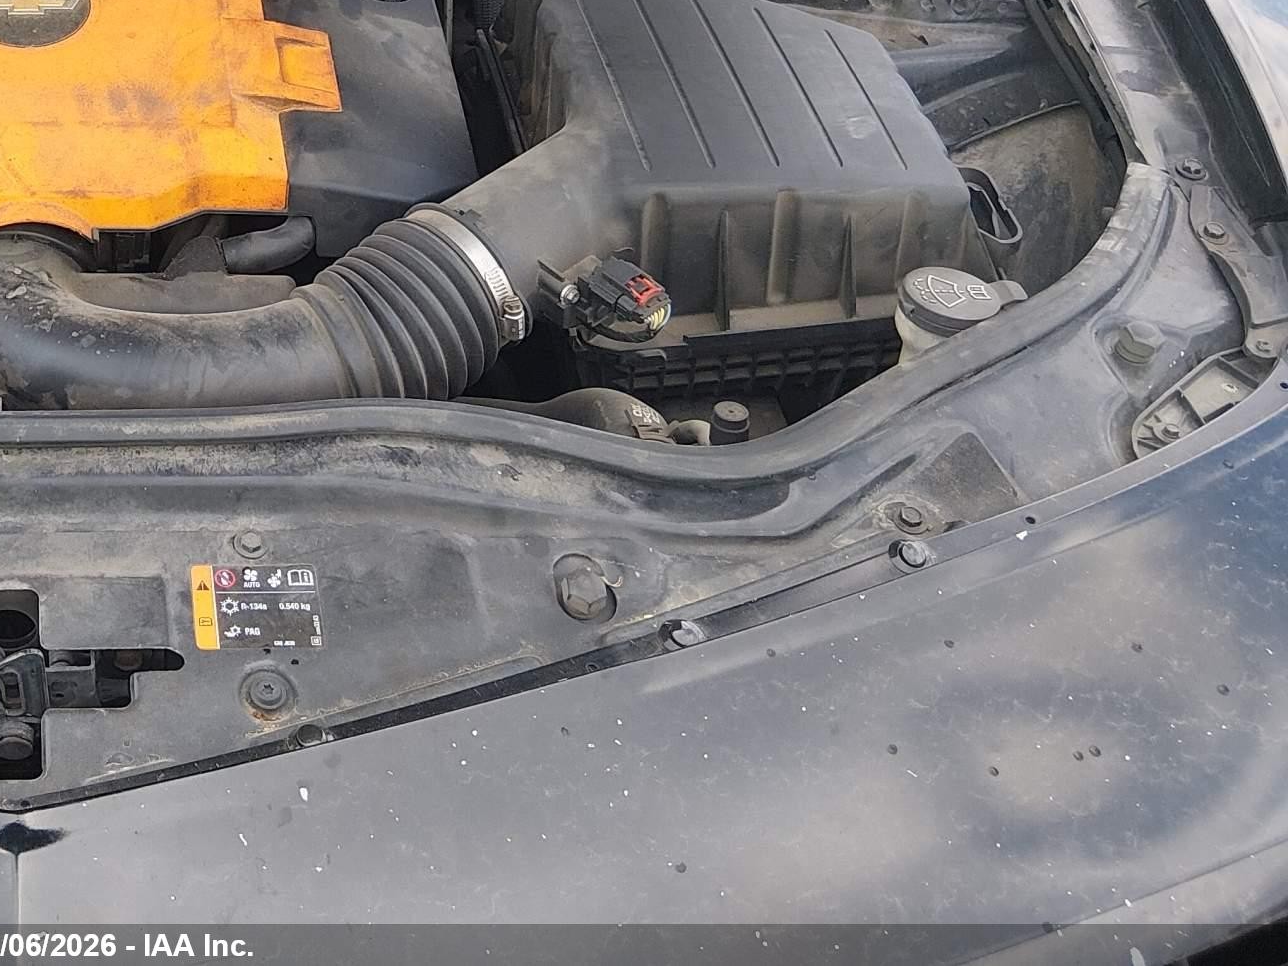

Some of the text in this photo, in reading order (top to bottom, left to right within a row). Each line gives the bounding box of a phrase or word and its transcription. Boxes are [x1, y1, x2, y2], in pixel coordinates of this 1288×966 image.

[240, 602, 268, 611] R-134a
[300, 602, 311, 611] kg
[244, 627, 261, 636] PAG
